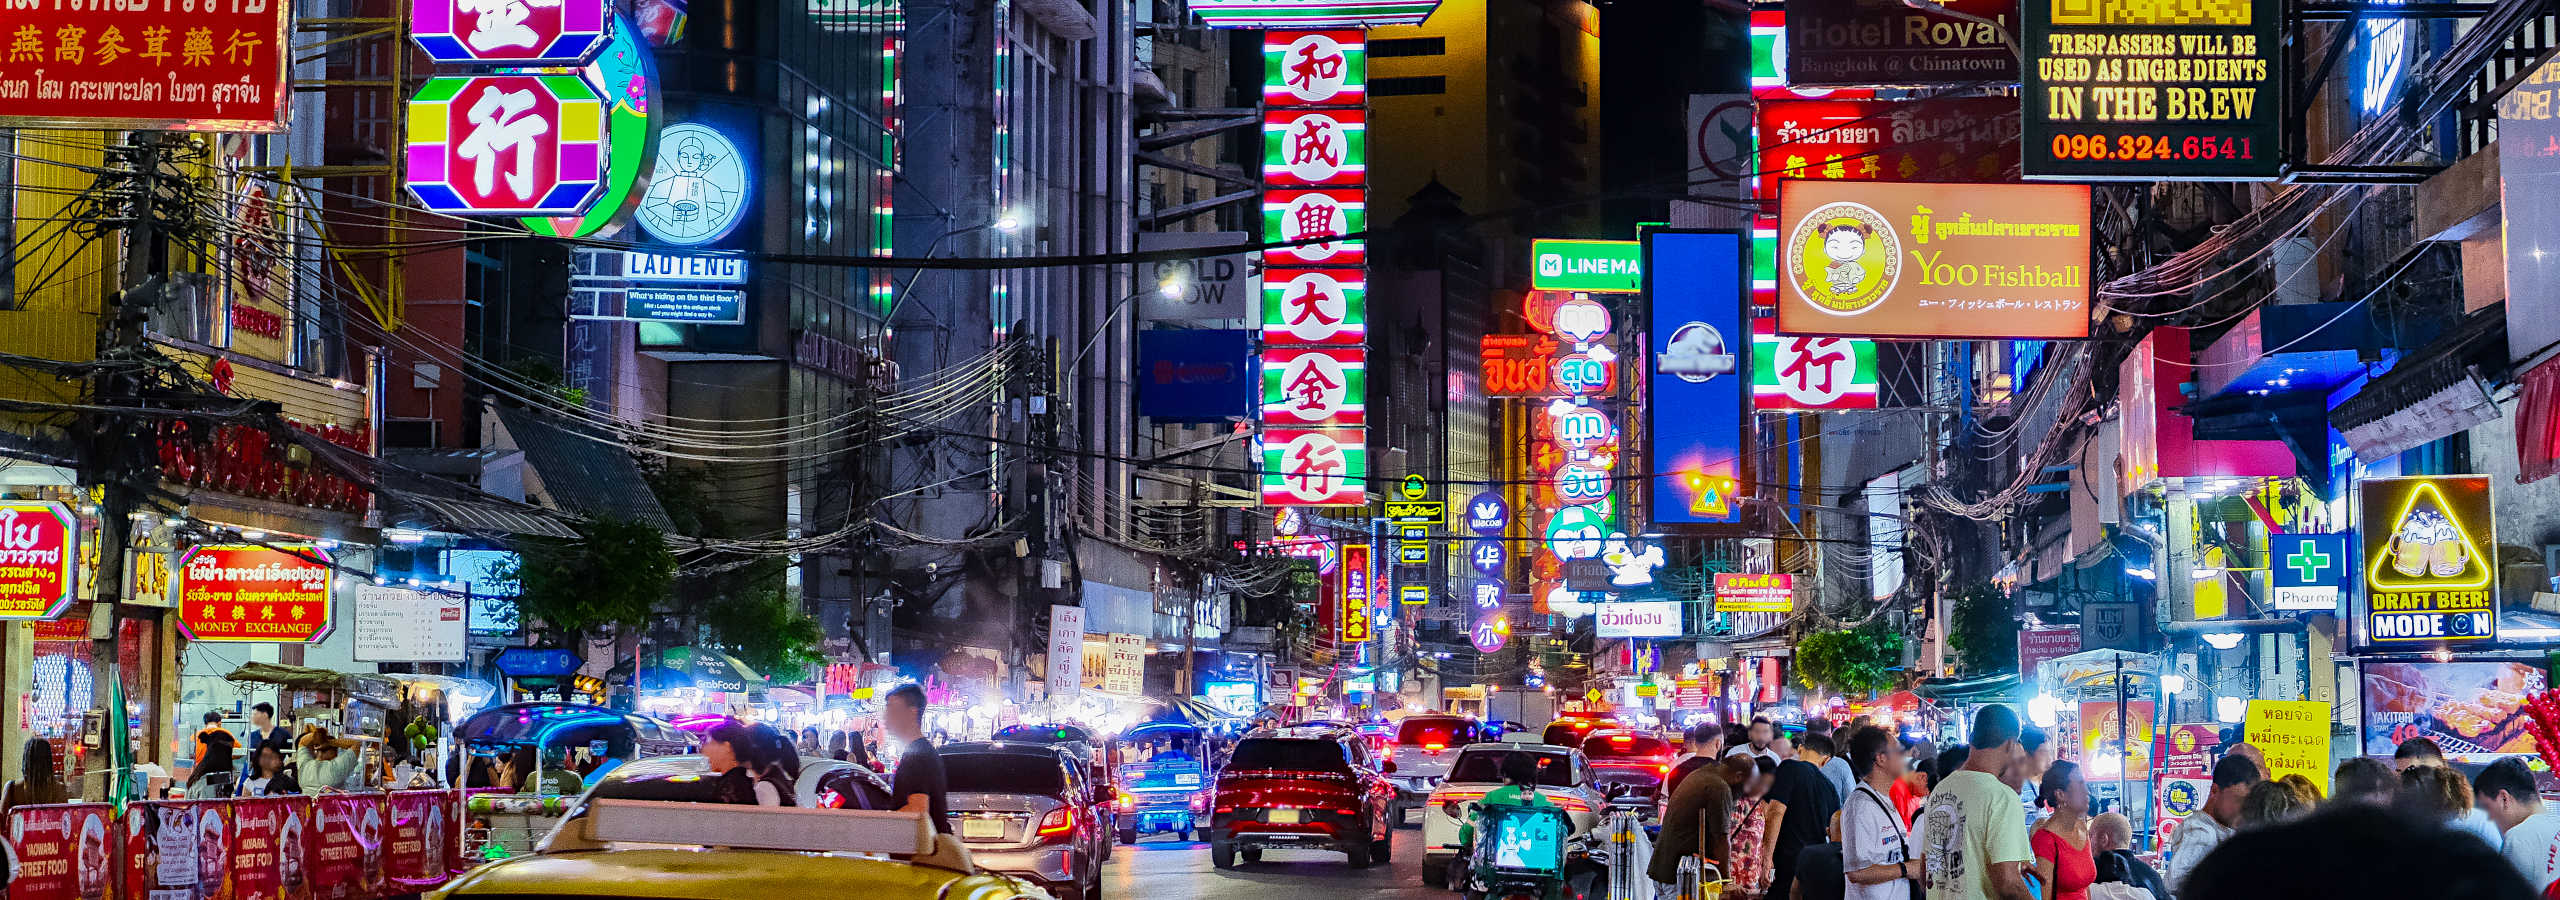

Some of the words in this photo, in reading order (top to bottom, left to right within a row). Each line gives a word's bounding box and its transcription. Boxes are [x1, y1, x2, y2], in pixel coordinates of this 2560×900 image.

[1800, 17, 1892, 46] Hotel
[1905, 14, 2006, 48] Royal
[9, 24, 263, 68] 燕窩參茸藥行
[2049, 34, 2176, 56] TRESPASSERS
[2179, 35, 2228, 56] WILL
[2232, 35, 2257, 56] BE
[1801, 57, 1878, 76] Bangkok
[1888, 58, 1901, 74] @
[1910, 56, 2006, 72] Chinatown
[2038, 58, 2091, 81] USED
[2096, 59, 2123, 82] AS
[2127, 59, 2267, 82] INGREDIENTS
[35, 69, 64, 99] โสม
[70, 78, 162, 103] กระเพาะปลา
[168, 71, 205, 104] ใบชา
[212, 75, 261, 114] สุราจีน
[2048, 86, 2084, 120] IN
[2092, 86, 2158, 121] THE
[2166, 86, 2256, 120] BREW
[1776, 120, 1881, 145] ร้านขายยา
[2052, 134, 2254, 161] 096.324.6541
[1567, 258, 1609, 274] LINE
[1911, 250, 1979, 286] Yoo
[1983, 264, 2081, 287] Fishball
[629, 291, 653, 300] What's
[655, 292, 675, 302] hiding
[687, 293, 698, 301] the
[700, 294, 715, 302] third
[717, 294, 732, 302] floor
[1166, 283, 1226, 305] OW
[1781, 337, 1846, 395] 行
[1564, 467, 1603, 495] วัน
[236, 588, 324, 603] เงินตราต่างประเทศ
[1476, 545, 1502, 647] 华歌尔
[2373, 592, 2431, 611] DRAFT
[2436, 591, 2490, 609] BEER!
[2098, 608, 2124, 623] LUMI
[2375, 614, 2444, 637] MODE
[194, 622, 238, 633] MONEY
[245, 623, 313, 634] EXCHANGE
[2096, 626, 2123, 641] NOX
[696, 680, 741, 691] GrabFood
[2372, 711, 2414, 724] YAKITORI
[19, 861, 48, 879] STREET
[48, 858, 68, 876] FOOD
[2547, 843, 2558, 875] THE
